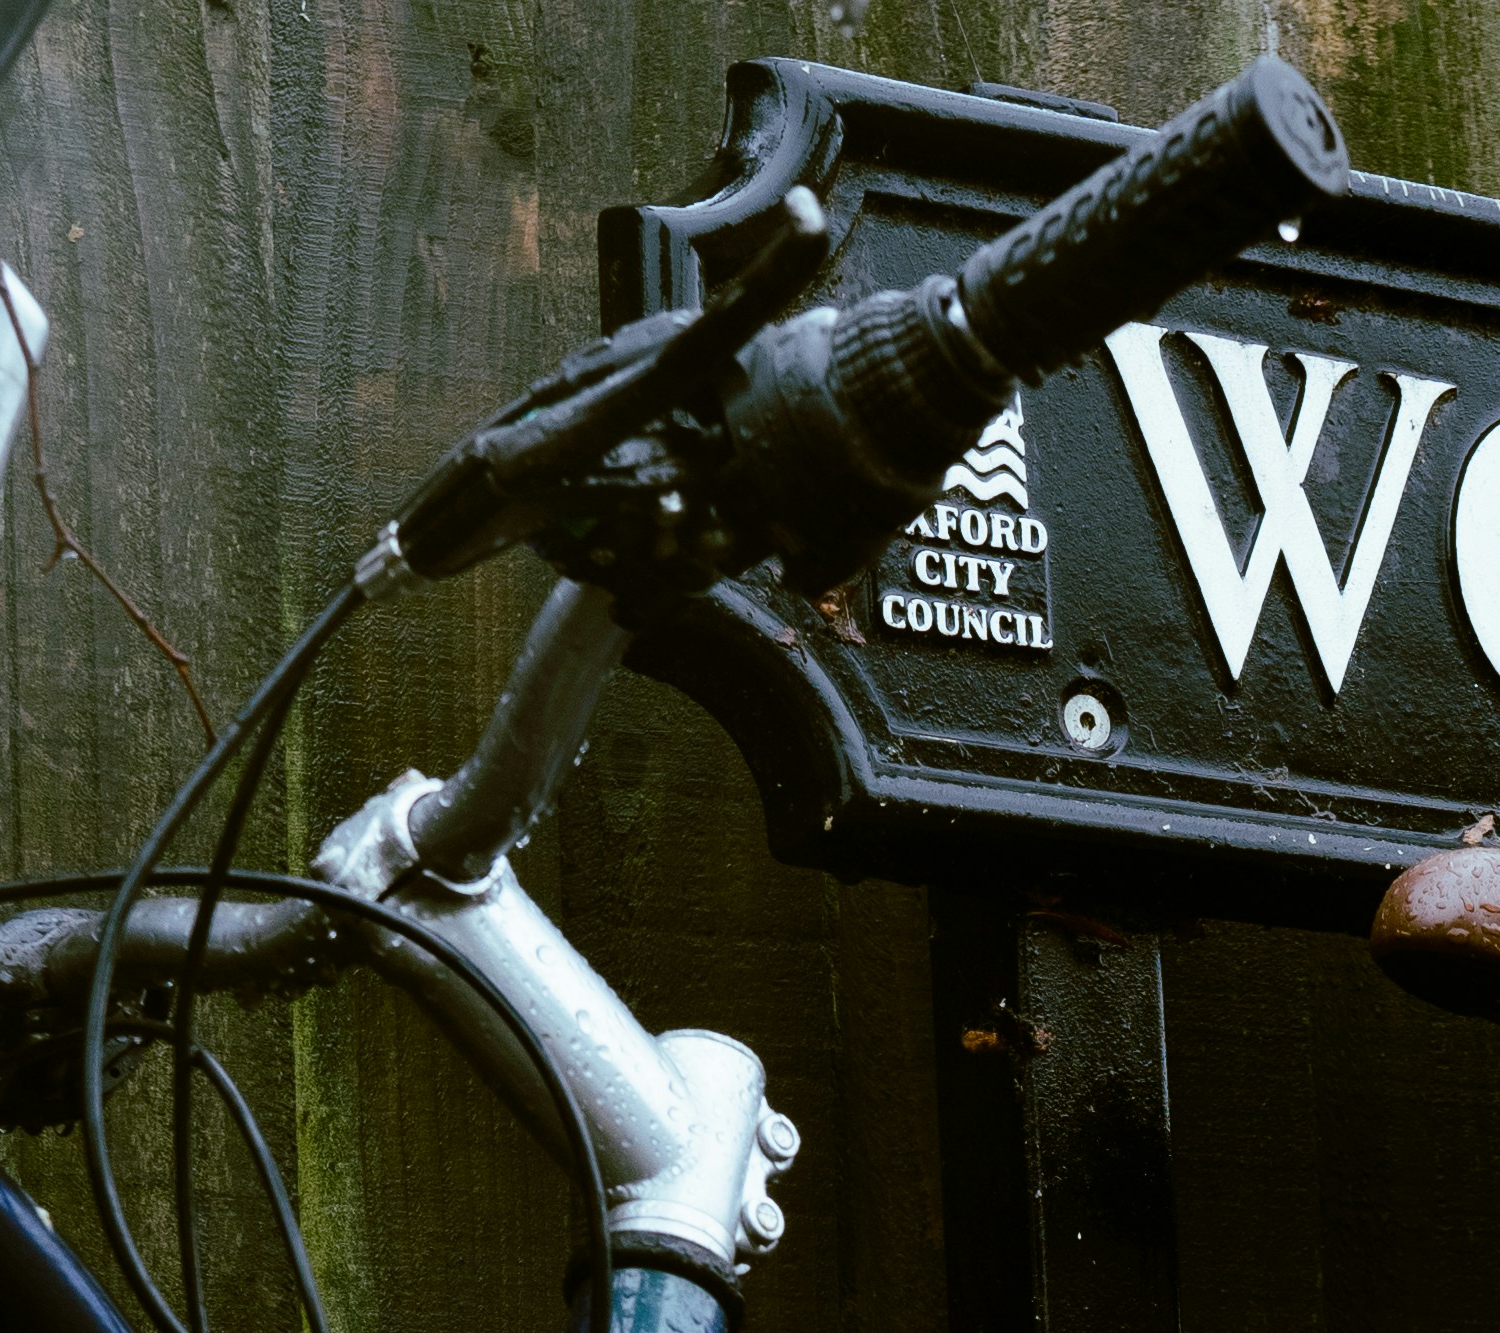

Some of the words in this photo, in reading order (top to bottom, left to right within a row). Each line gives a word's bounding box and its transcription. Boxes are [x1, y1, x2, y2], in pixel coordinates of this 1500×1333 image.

[904, 504, 1049, 554] XFORD
[915, 550, 1015, 596] CITY
[882, 595, 1054, 649] COUNCIL
